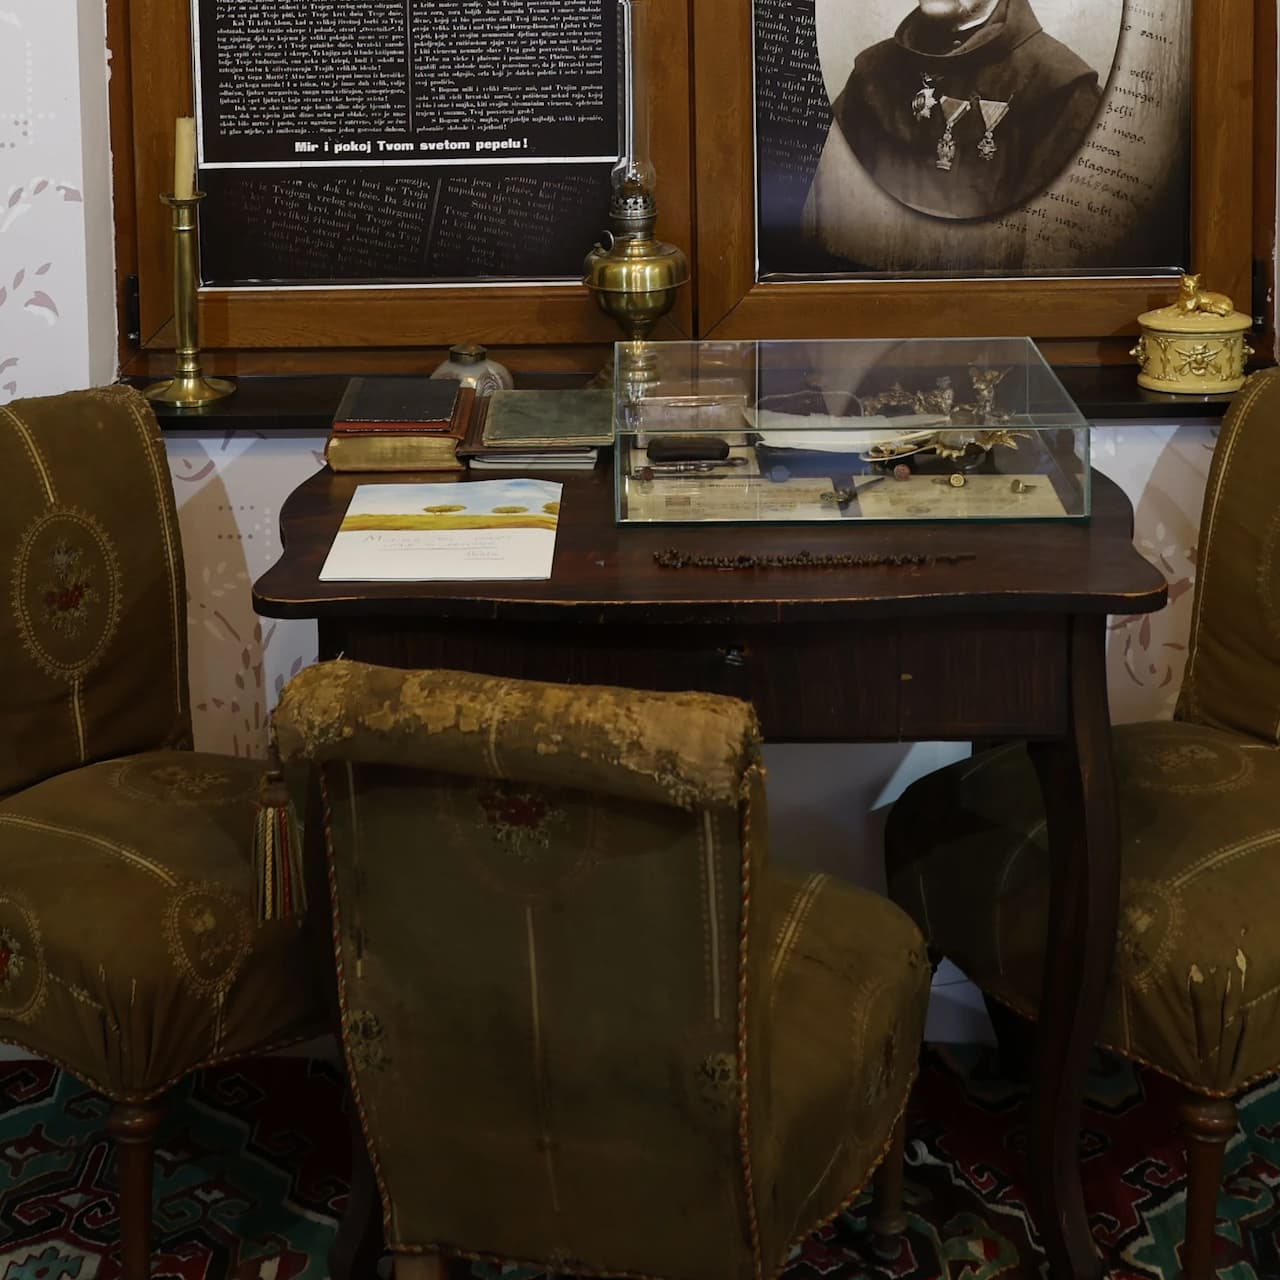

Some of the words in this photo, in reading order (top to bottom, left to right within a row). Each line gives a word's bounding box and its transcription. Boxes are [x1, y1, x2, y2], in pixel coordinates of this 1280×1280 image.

[294, 141, 319, 152] Mir
[324, 141, 328, 151] i
[334, 140, 371, 153] pokoj
[376, 140, 414, 151] Tvom
[419, 139, 470, 150] svetom
